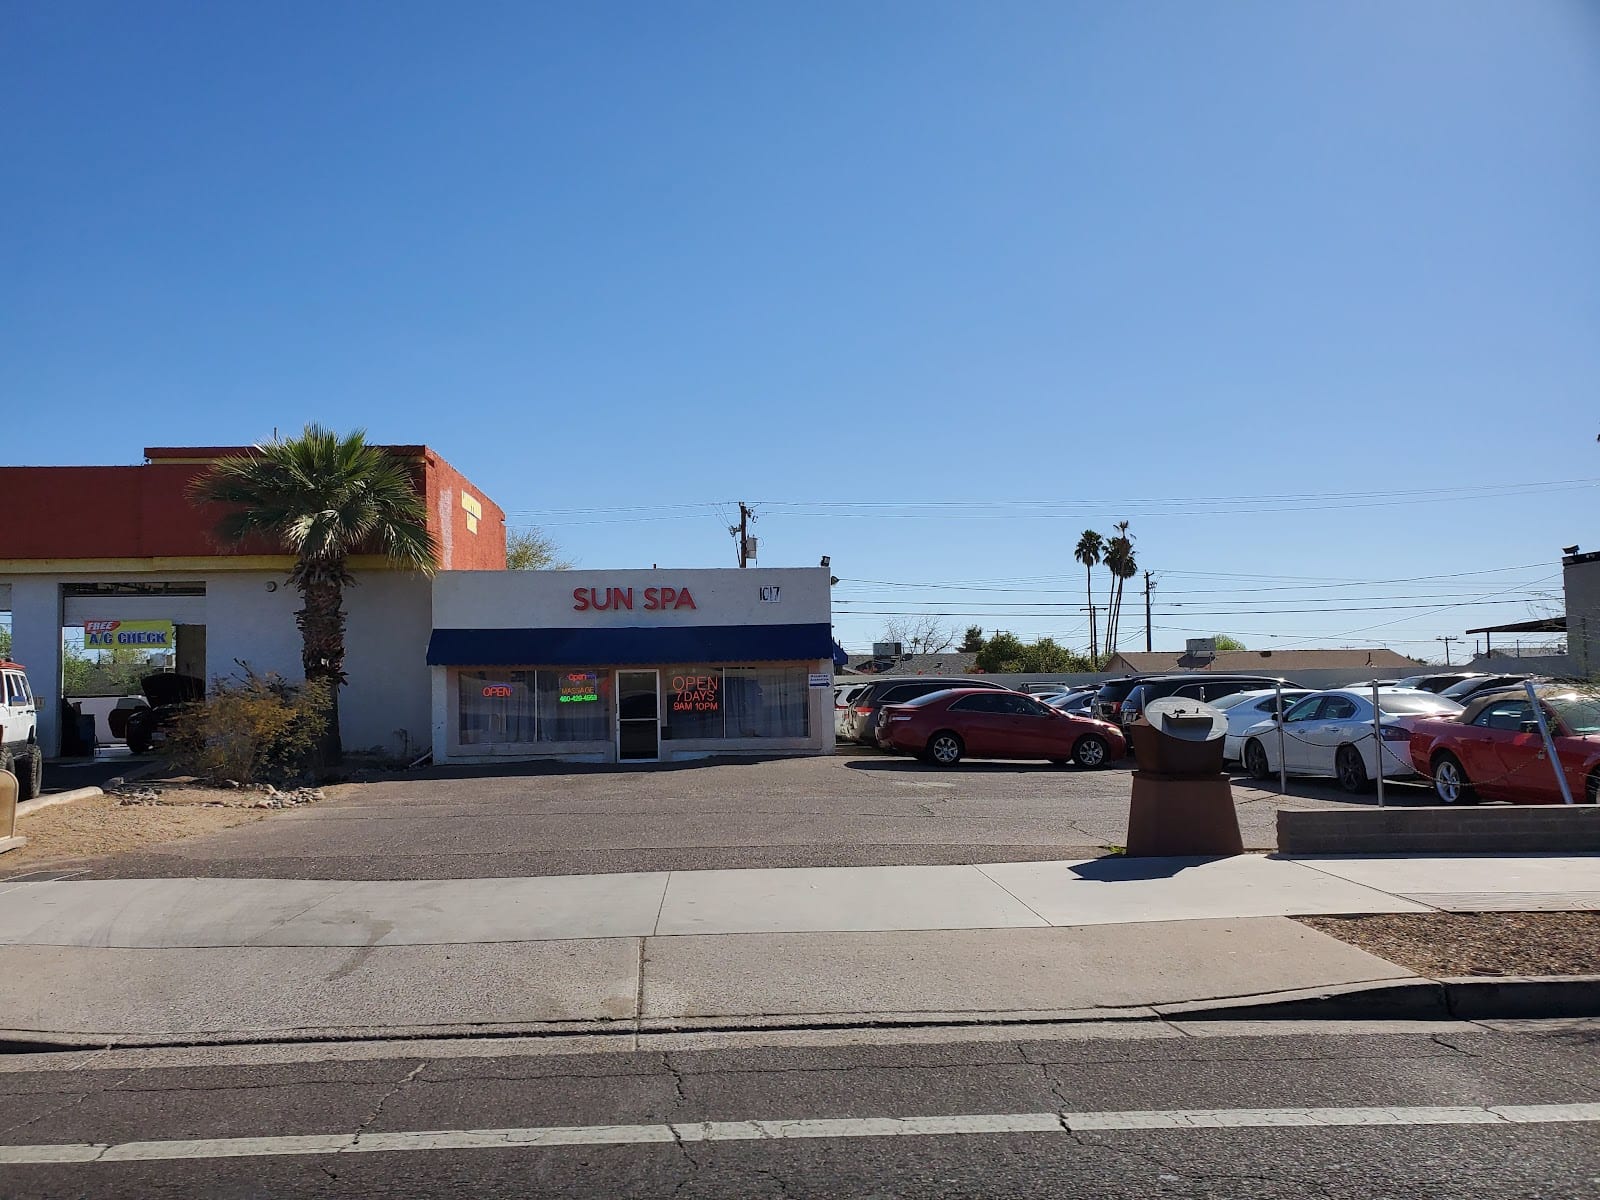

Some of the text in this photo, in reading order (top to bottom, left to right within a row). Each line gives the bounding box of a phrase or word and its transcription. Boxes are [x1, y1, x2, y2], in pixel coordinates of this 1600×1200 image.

[573, 587, 697, 611] SUN SPA
[87, 621, 114, 630] FREE
[89, 631, 167, 645] A/C CHECK
[672, 676, 719, 691] OPEN
[482, 687, 512, 697] OPEN
[561, 687, 594, 695] MASSAGE
[677, 690, 715, 702] 7 DAYS
[673, 702, 718, 711] 9AM 10PM
